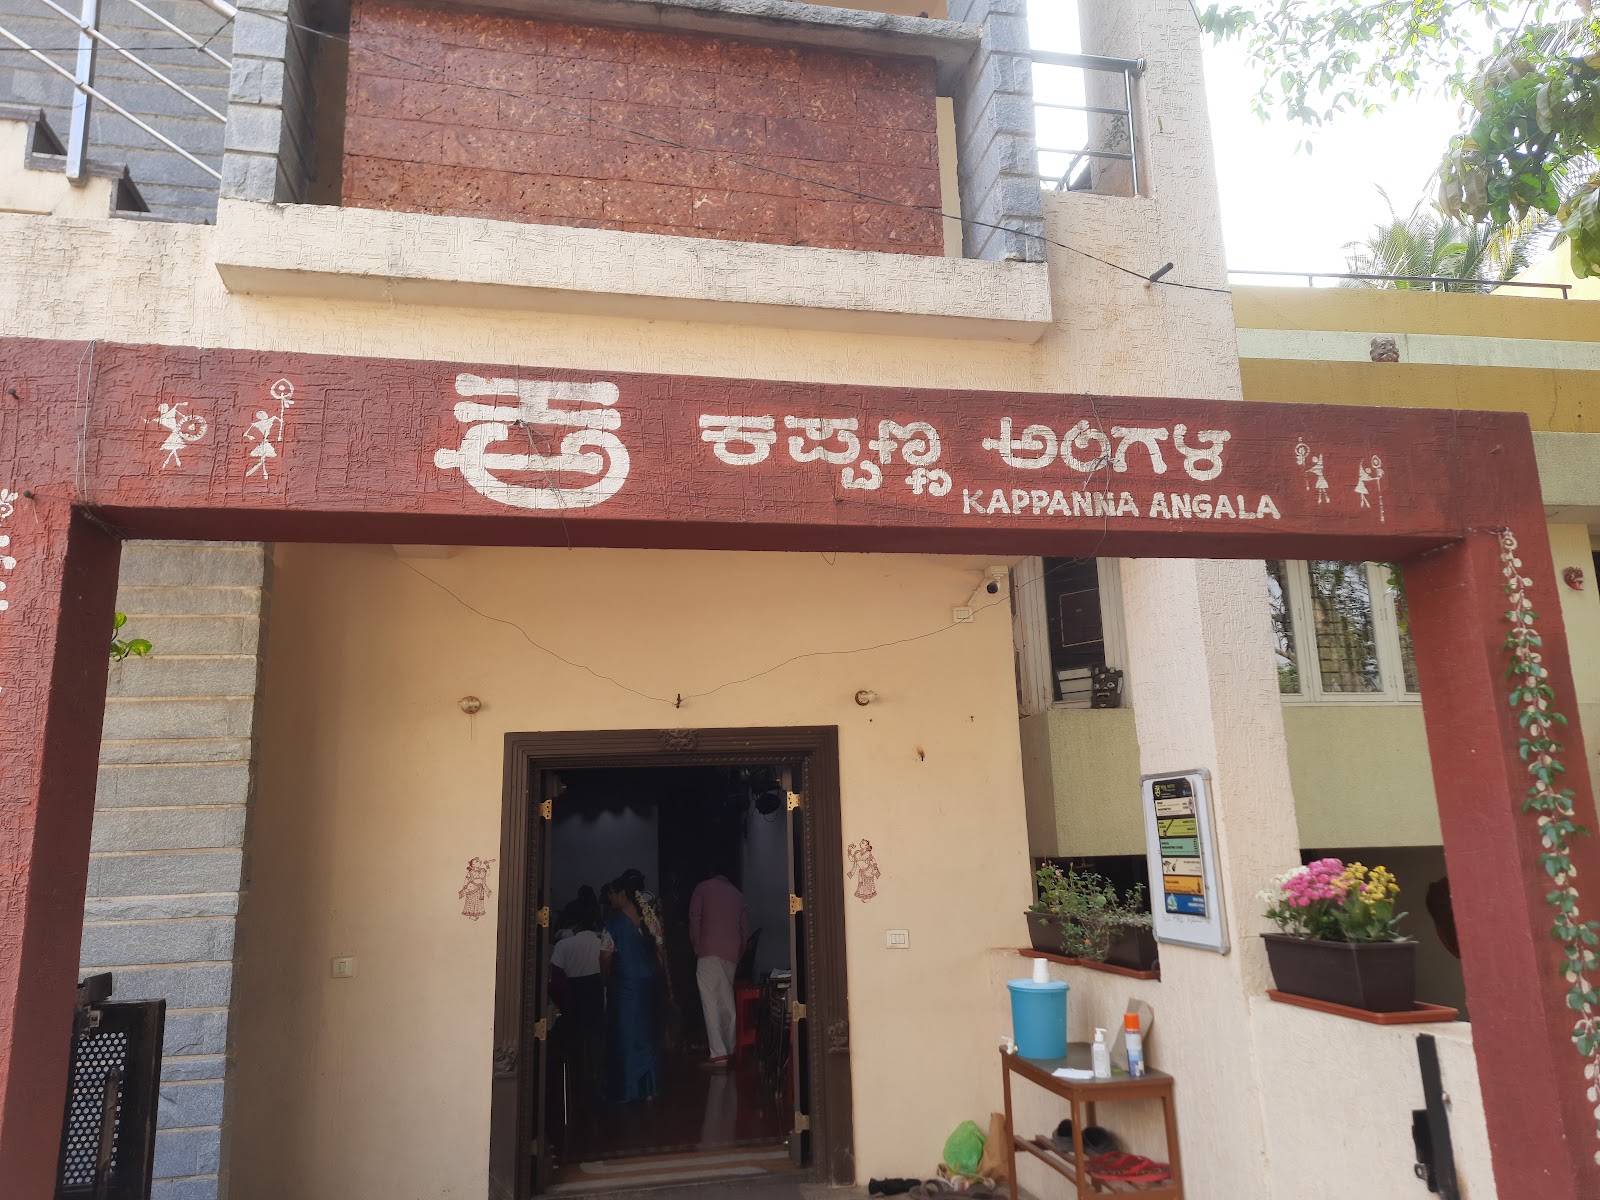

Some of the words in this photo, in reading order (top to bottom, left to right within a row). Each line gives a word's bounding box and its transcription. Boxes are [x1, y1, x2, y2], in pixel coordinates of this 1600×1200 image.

[699, 413, 953, 497] ಕಪ್ಪಣ್ಣ
[981, 416, 1232, 482] ಅಂಗಳ
[962, 488, 1140, 518] KAPPANNA
[1149, 492, 1281, 520] ANGALA
